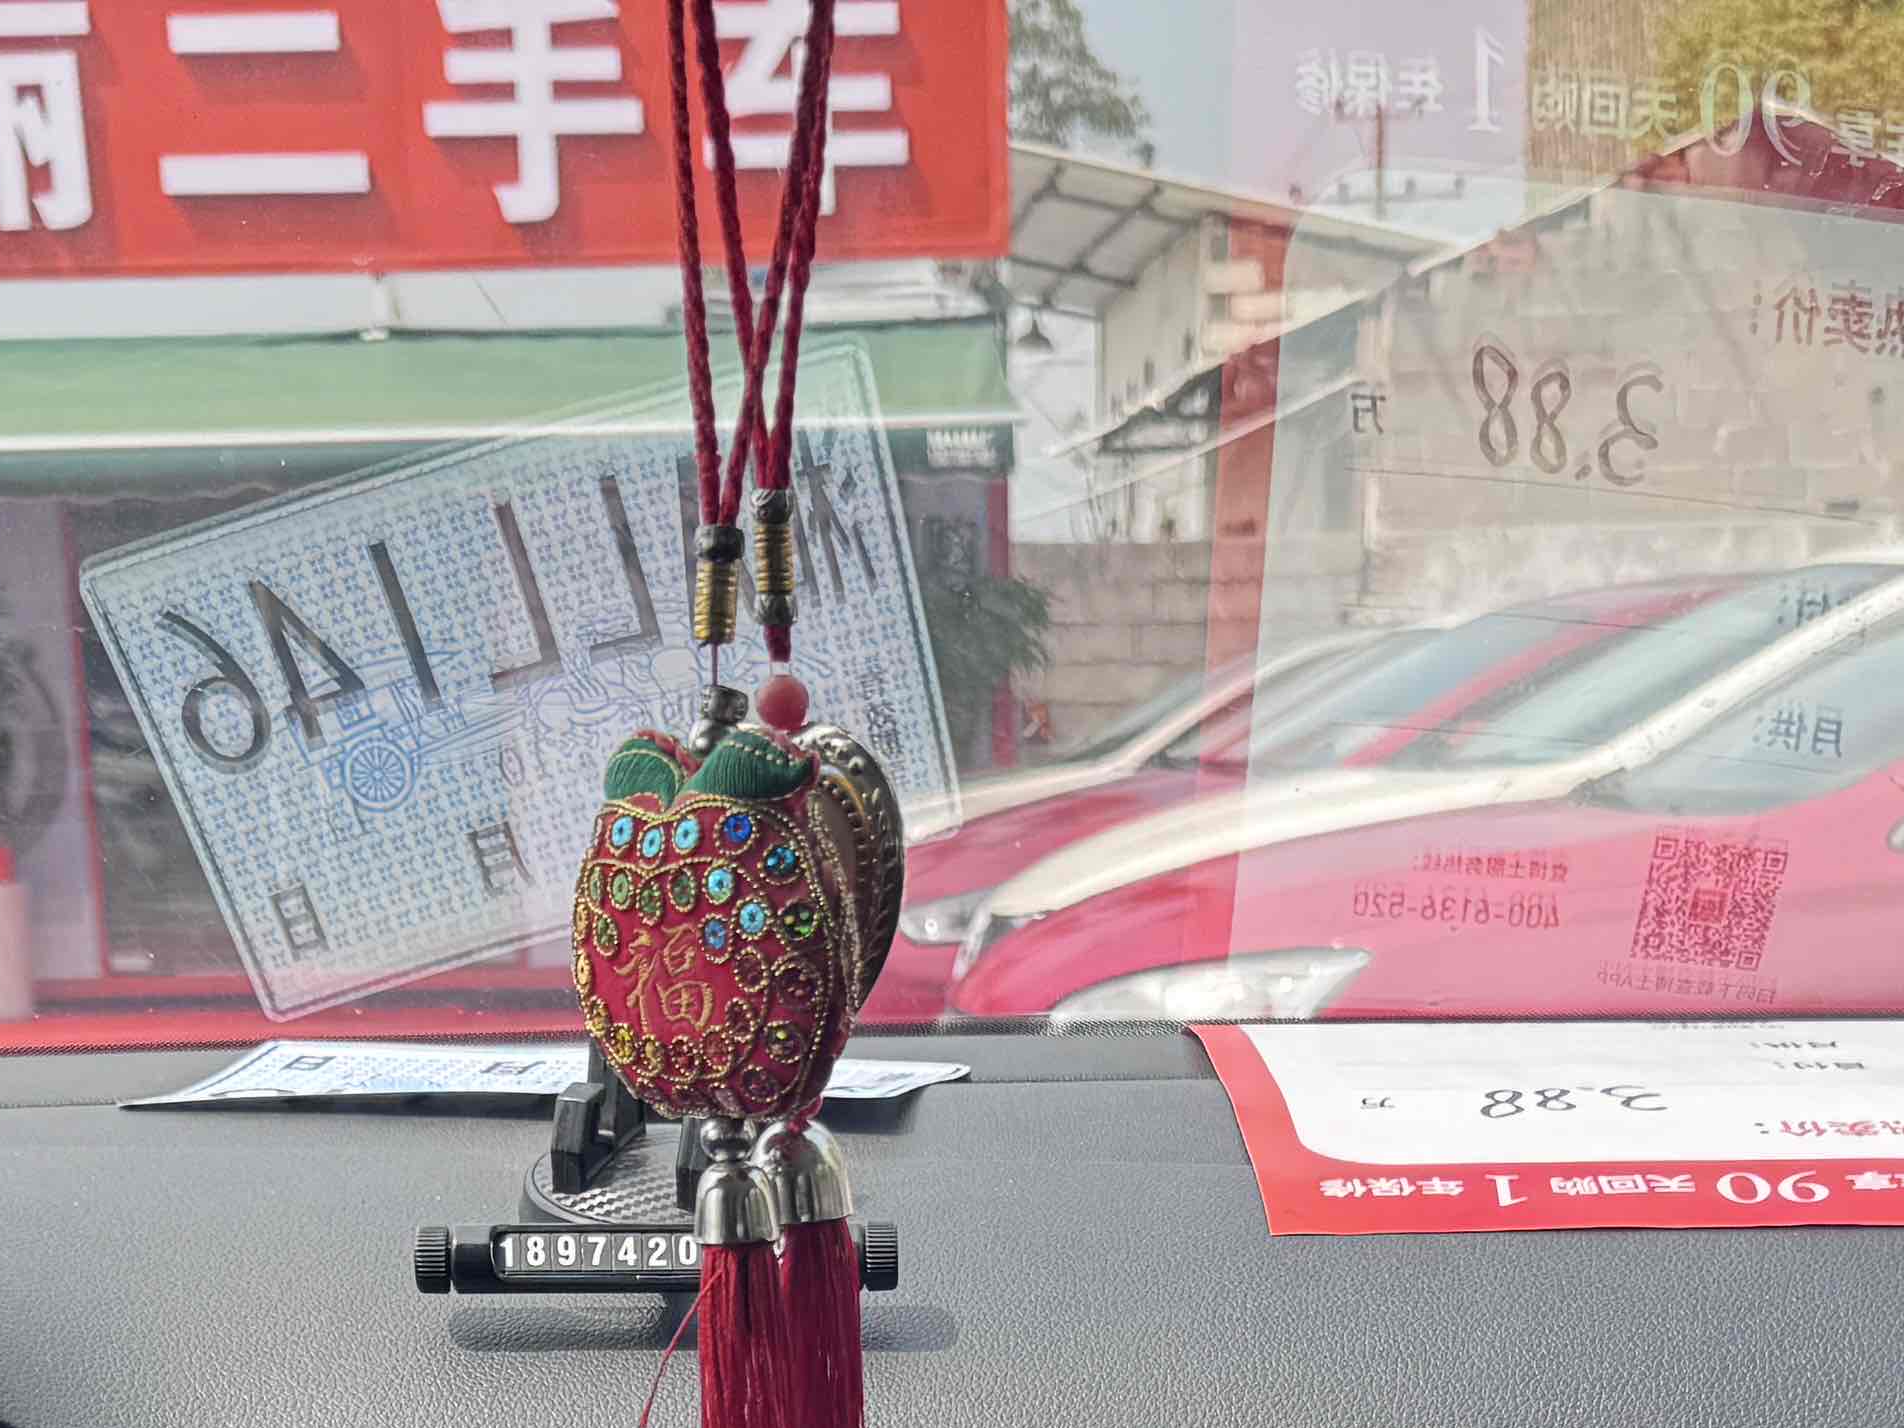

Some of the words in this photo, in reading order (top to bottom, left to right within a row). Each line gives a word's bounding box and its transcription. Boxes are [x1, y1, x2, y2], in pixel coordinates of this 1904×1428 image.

[613, 923, 714, 1034] 福
[1477, 1085, 1670, 1119] 3.88
[1317, 1176, 1465, 1198] 年保修
[1482, 1174, 1528, 1208] 1
[1548, 1174, 1697, 1196] 天回购
[1715, 1170, 1832, 1206] 90
